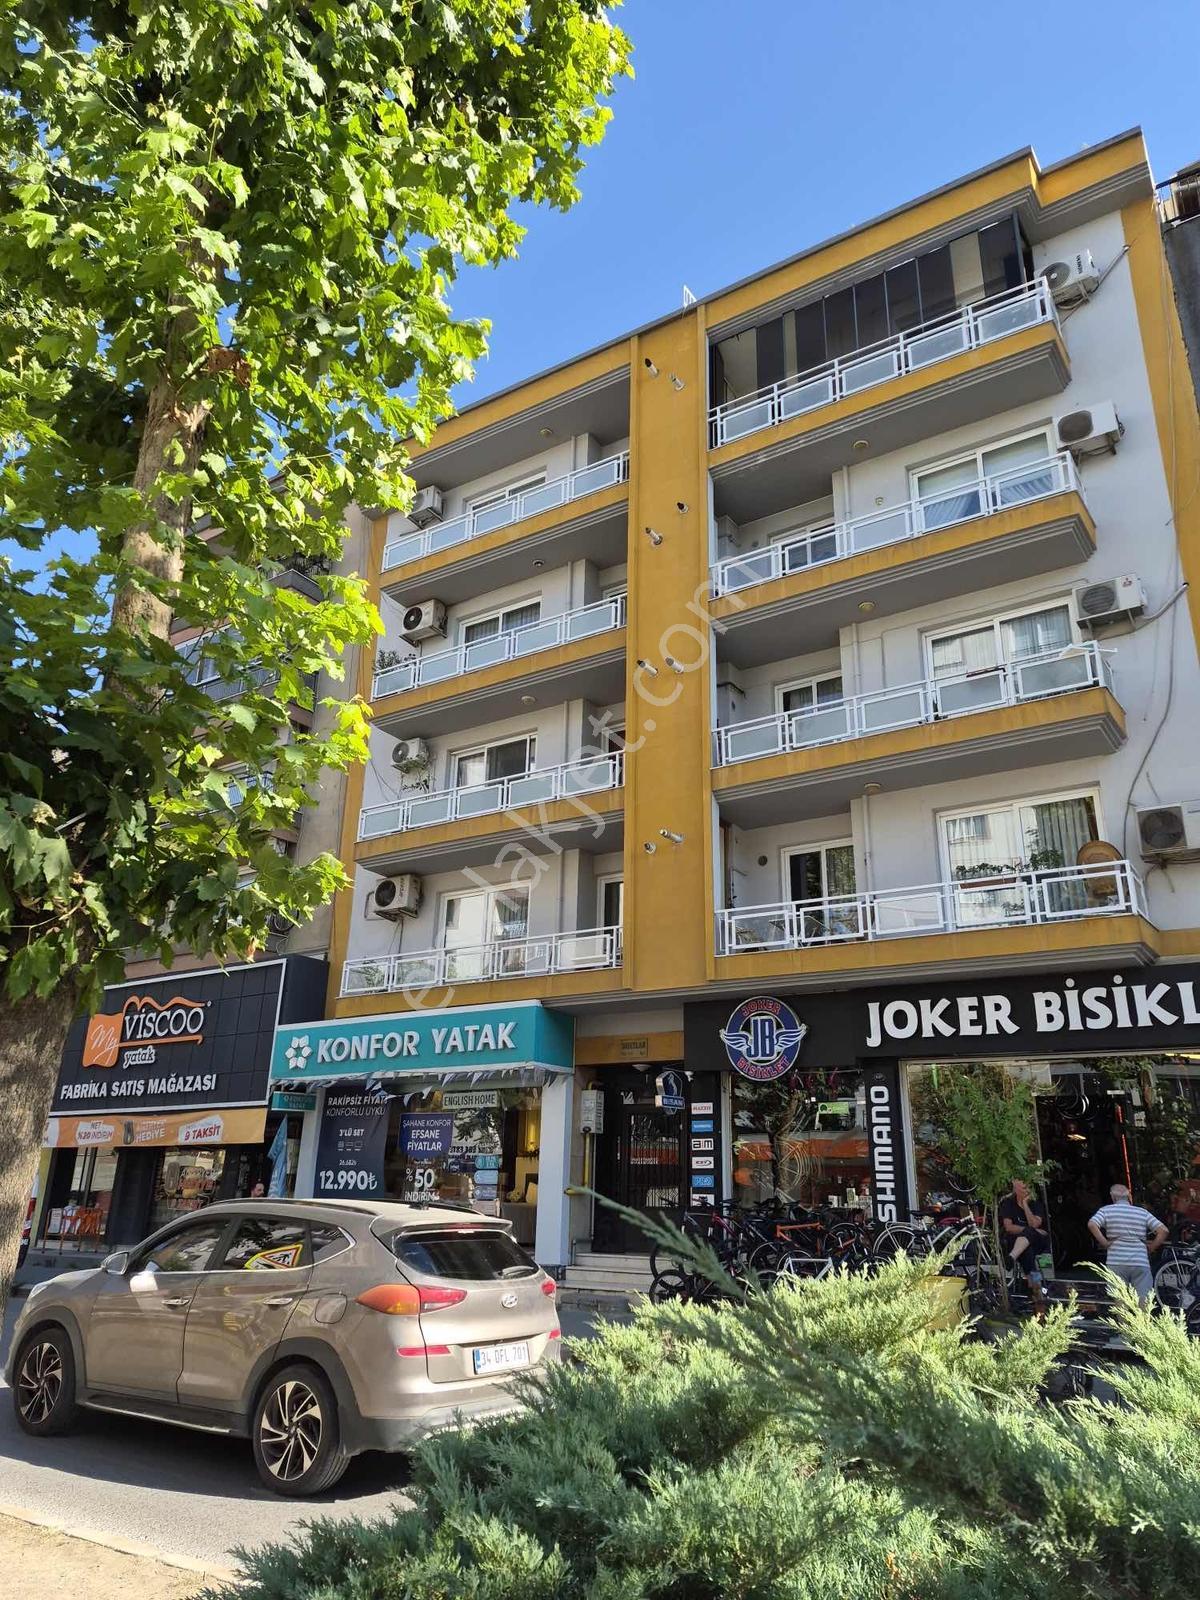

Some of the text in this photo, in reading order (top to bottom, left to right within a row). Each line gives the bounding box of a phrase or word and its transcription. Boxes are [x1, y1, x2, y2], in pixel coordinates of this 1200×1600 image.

[741, 999, 781, 1017] JOKER
[124, 1007, 204, 1041] VİSCOO
[866, 994, 1020, 1048] JOKER
[317, 1021, 520, 1064] KONFOR YATAK
[746, 1017, 776, 1059] JB
[123, 1045, 155, 1069] yatak
[60, 1072, 217, 1100] FABRİKA SATIŞ MAĞAZASI
[327, 1094, 362, 1106] RAKİPSİZ
[444, 1093, 496, 1107] ENGLISH HOME
[326, 1106, 386, 1117] KONFORLU UYKU
[402, 1118, 452, 1128] ŞAHANE KONFOR
[184, 1130, 191, 1141] 9
[192, 1124, 222, 1140] TAKSİT
[353, 1128, 365, 1137] SET
[411, 1129, 440, 1139] EFSANE
[407, 1140, 442, 1151] FİYATLAR
[870, 1085, 898, 1224] SHIMANO
[319, 1170, 378, 1190] 12.990₺
[481, 1350, 491, 1366] 34
